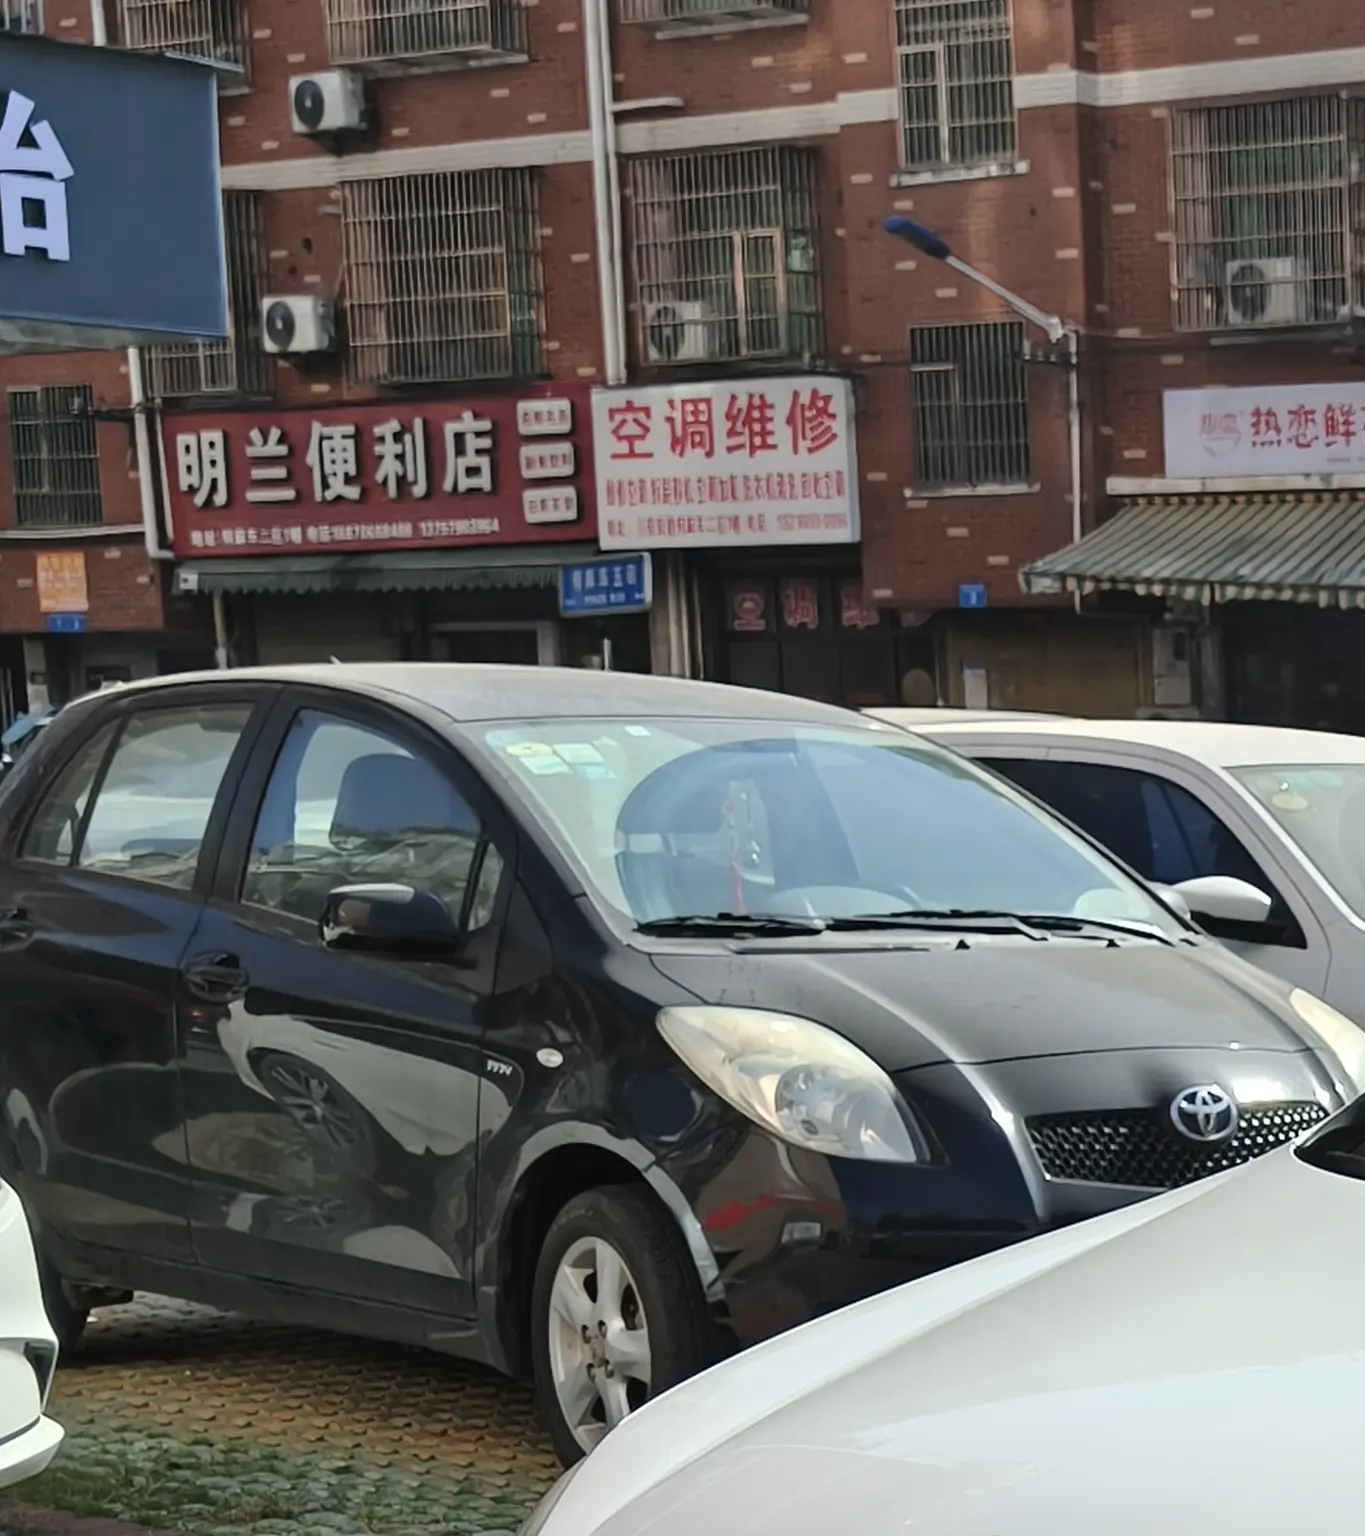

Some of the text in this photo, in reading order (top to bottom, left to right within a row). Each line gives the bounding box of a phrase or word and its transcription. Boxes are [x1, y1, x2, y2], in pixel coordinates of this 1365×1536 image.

[176, 410, 494, 508] 明兰便利店
[608, 388, 838, 460] 空调维修
